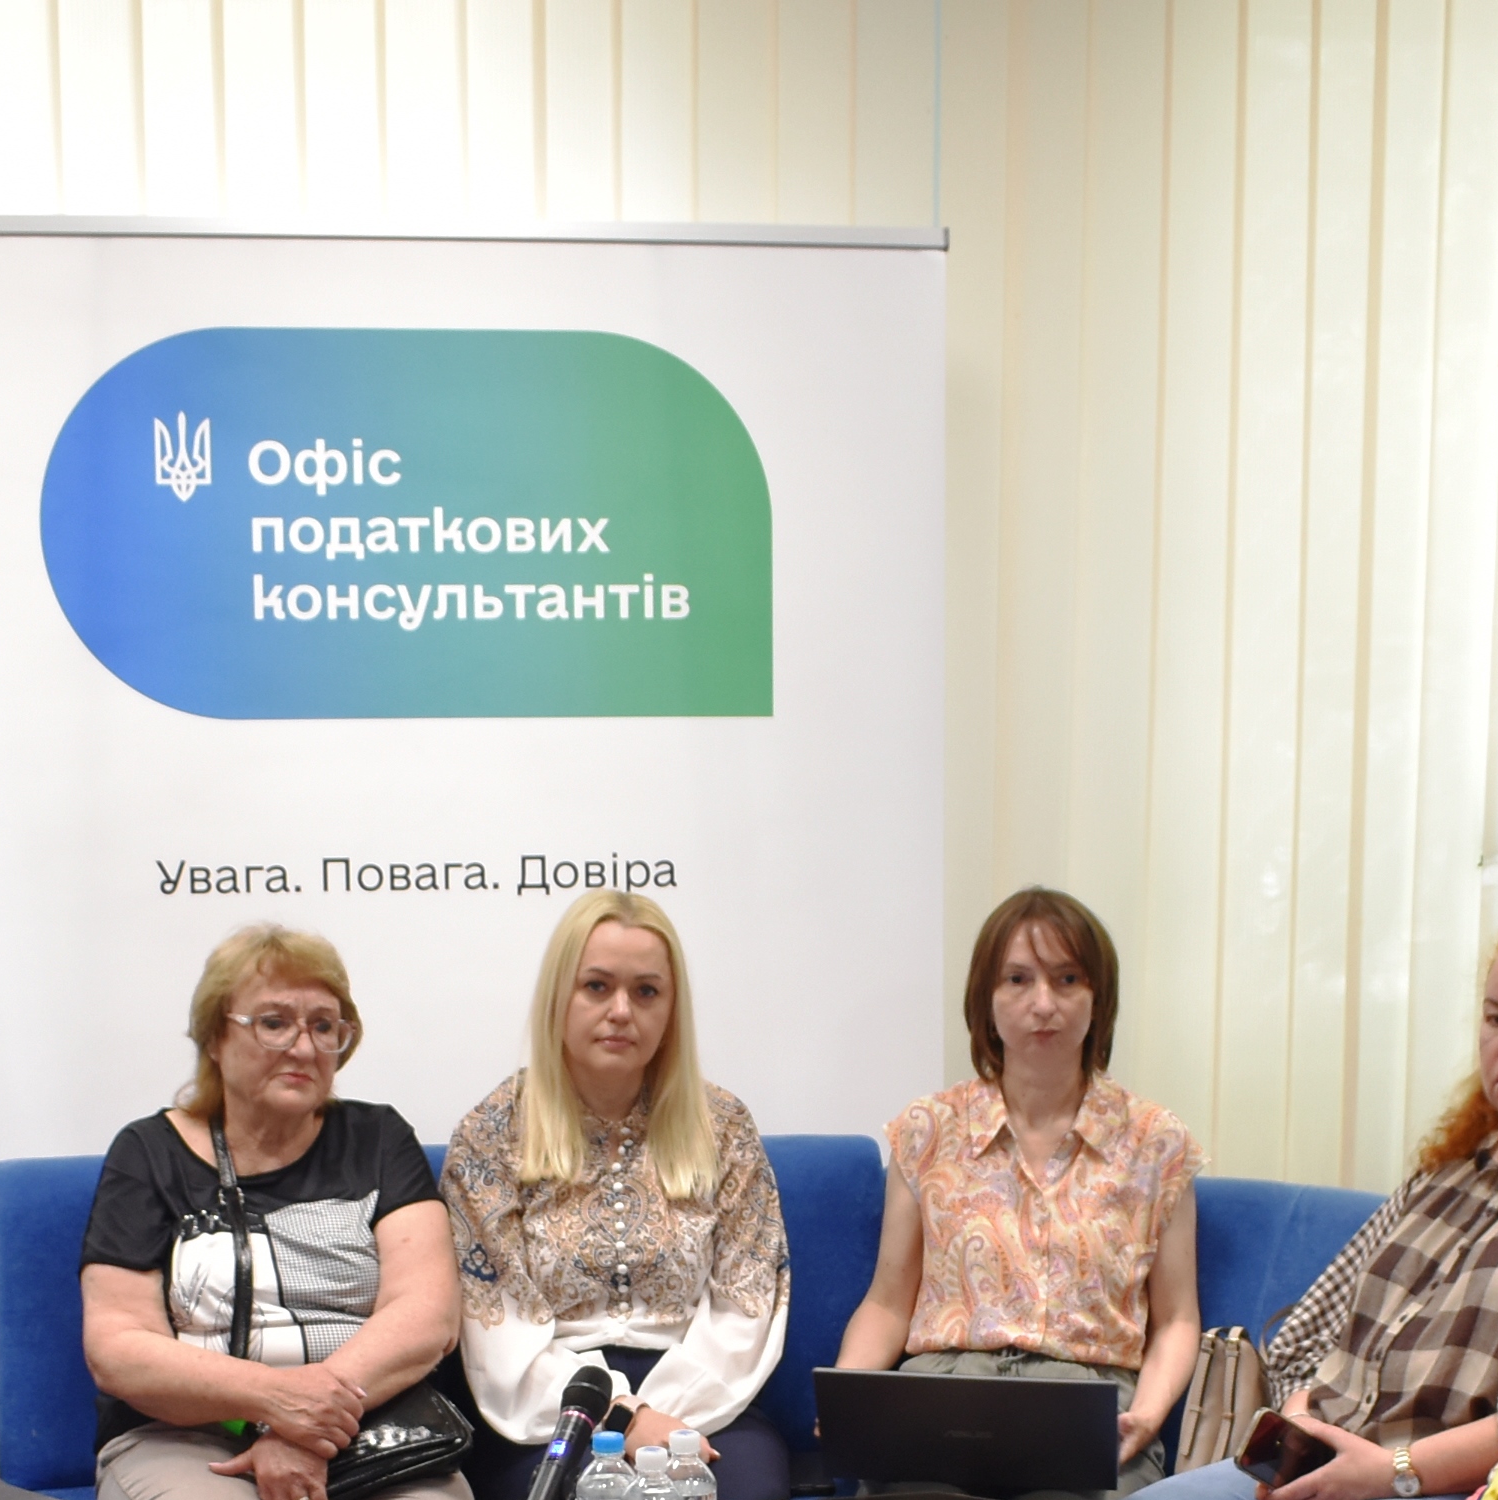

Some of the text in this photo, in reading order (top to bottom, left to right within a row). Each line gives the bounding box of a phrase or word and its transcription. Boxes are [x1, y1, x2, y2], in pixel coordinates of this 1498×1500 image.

[248, 438, 402, 495] Офіс
[251, 507, 611, 560] податкових
[253, 573, 691, 630] консультантів
[156, 852, 679, 896] Увага. Повага. Довіра
